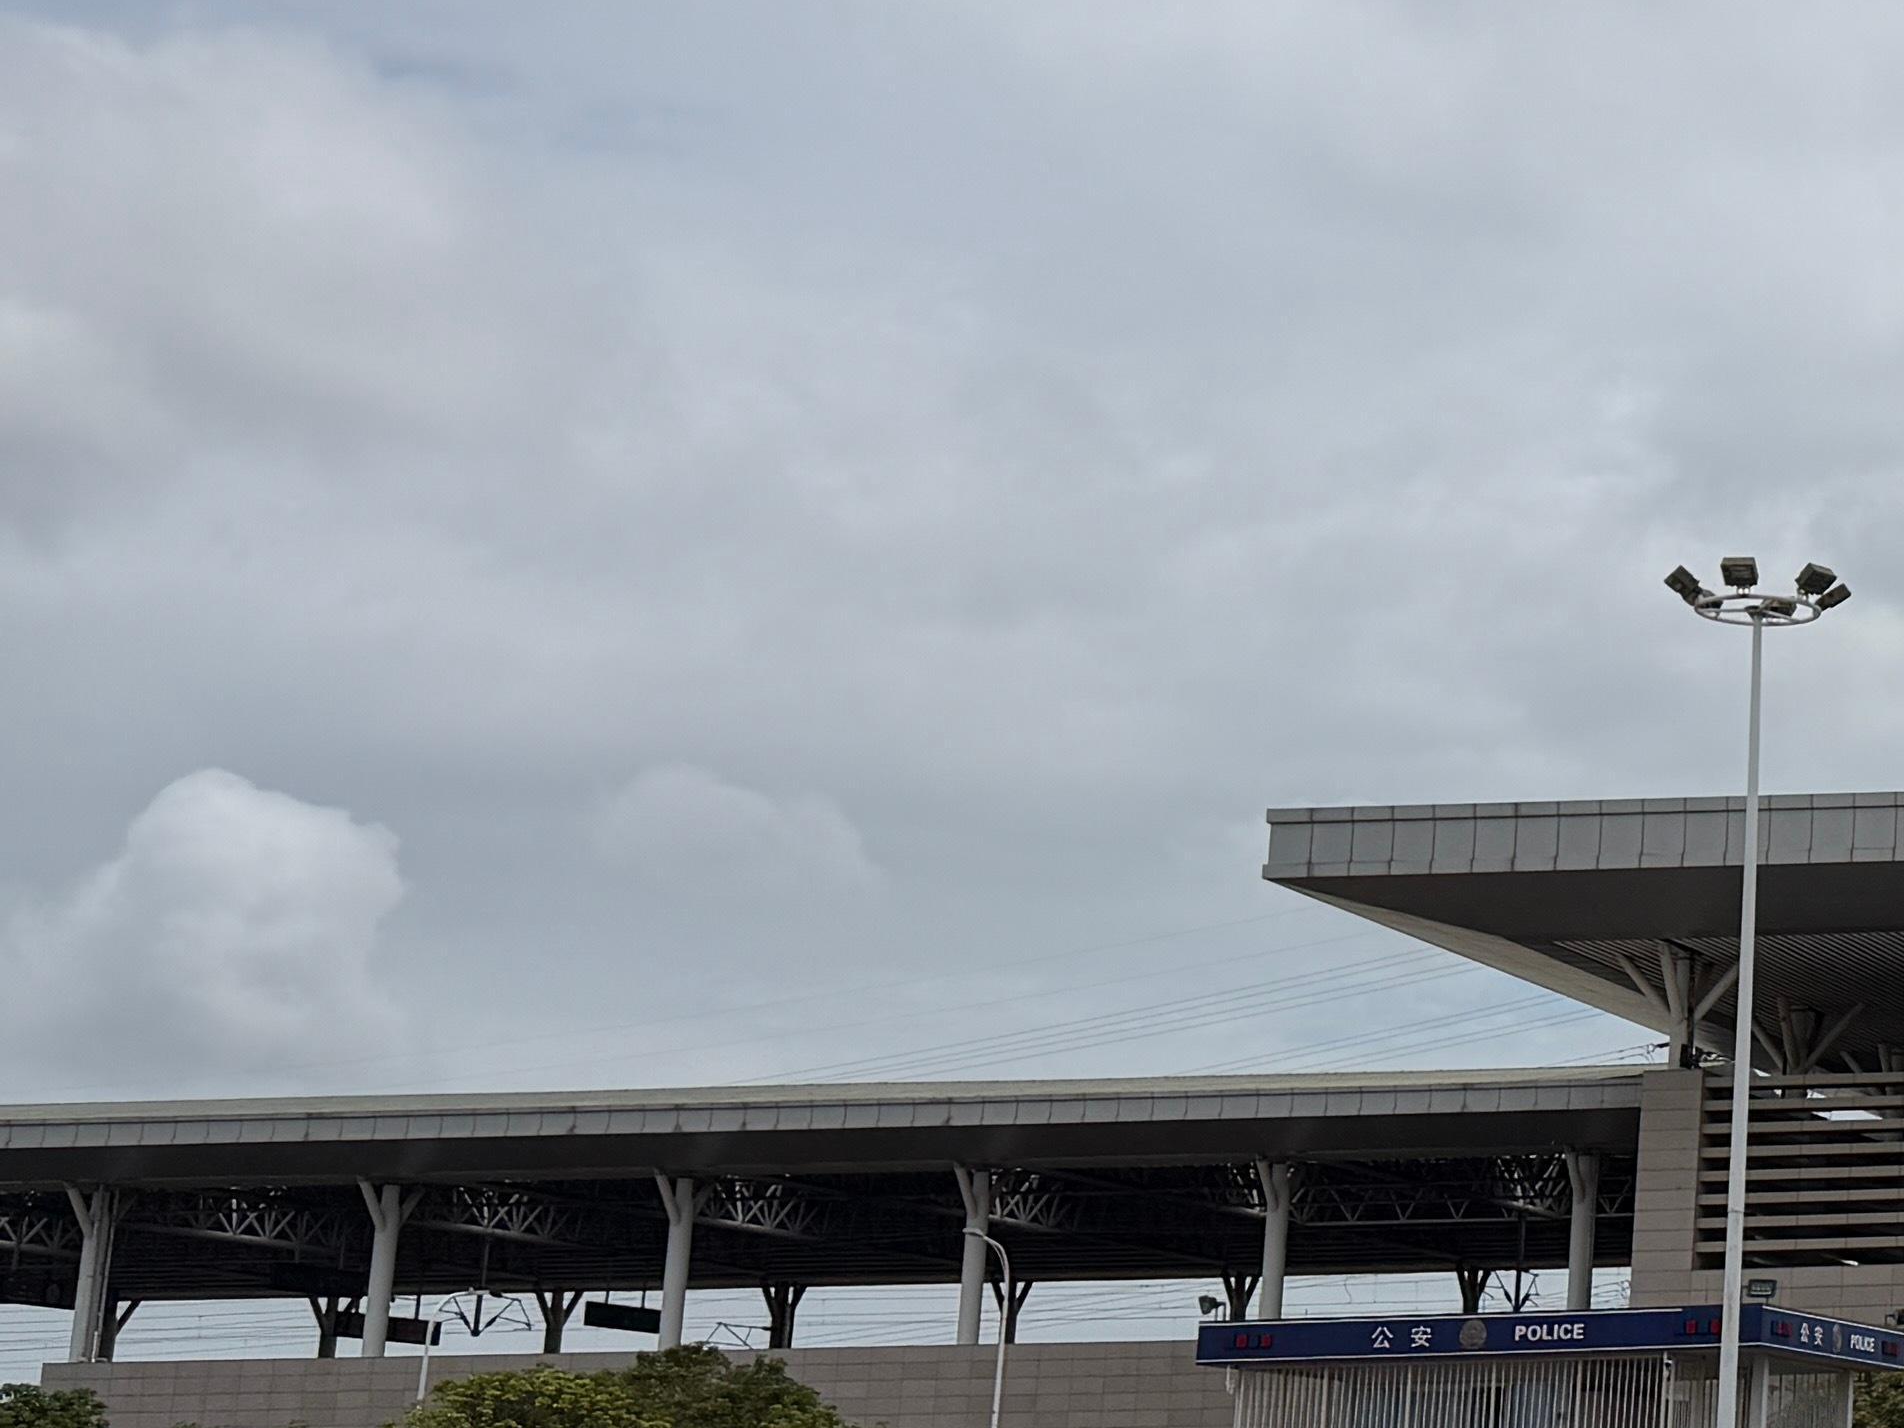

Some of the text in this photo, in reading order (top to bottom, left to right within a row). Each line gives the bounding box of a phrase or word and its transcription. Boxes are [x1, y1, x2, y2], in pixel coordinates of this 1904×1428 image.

[1371, 1325, 1433, 1349] 公安
[1513, 1323, 1585, 1342] POLICE
[1850, 1334, 1875, 1352] POLICE
